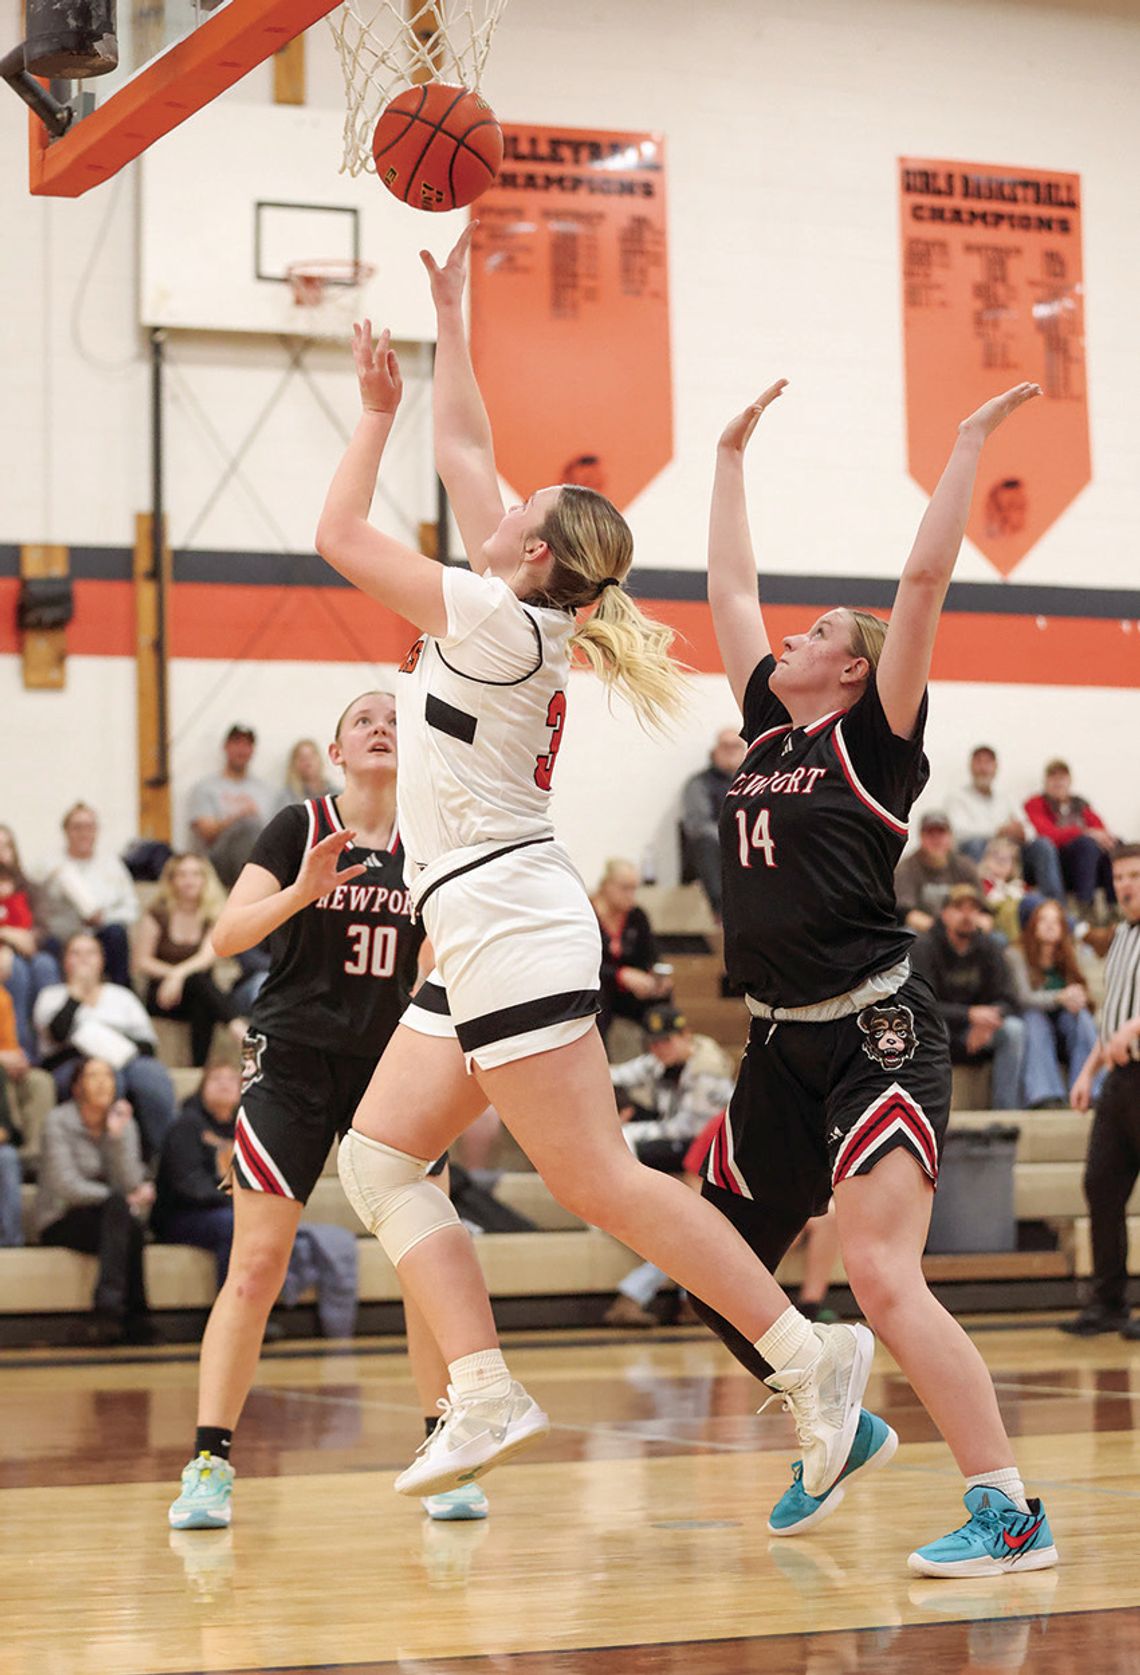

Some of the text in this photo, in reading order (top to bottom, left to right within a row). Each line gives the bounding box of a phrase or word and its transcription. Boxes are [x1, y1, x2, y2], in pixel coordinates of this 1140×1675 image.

[496, 171, 654, 198] HAMPIONS
[911, 204, 1070, 234] CHAMPIONS
[735, 808, 778, 869] 14
[343, 923, 398, 978] 30
